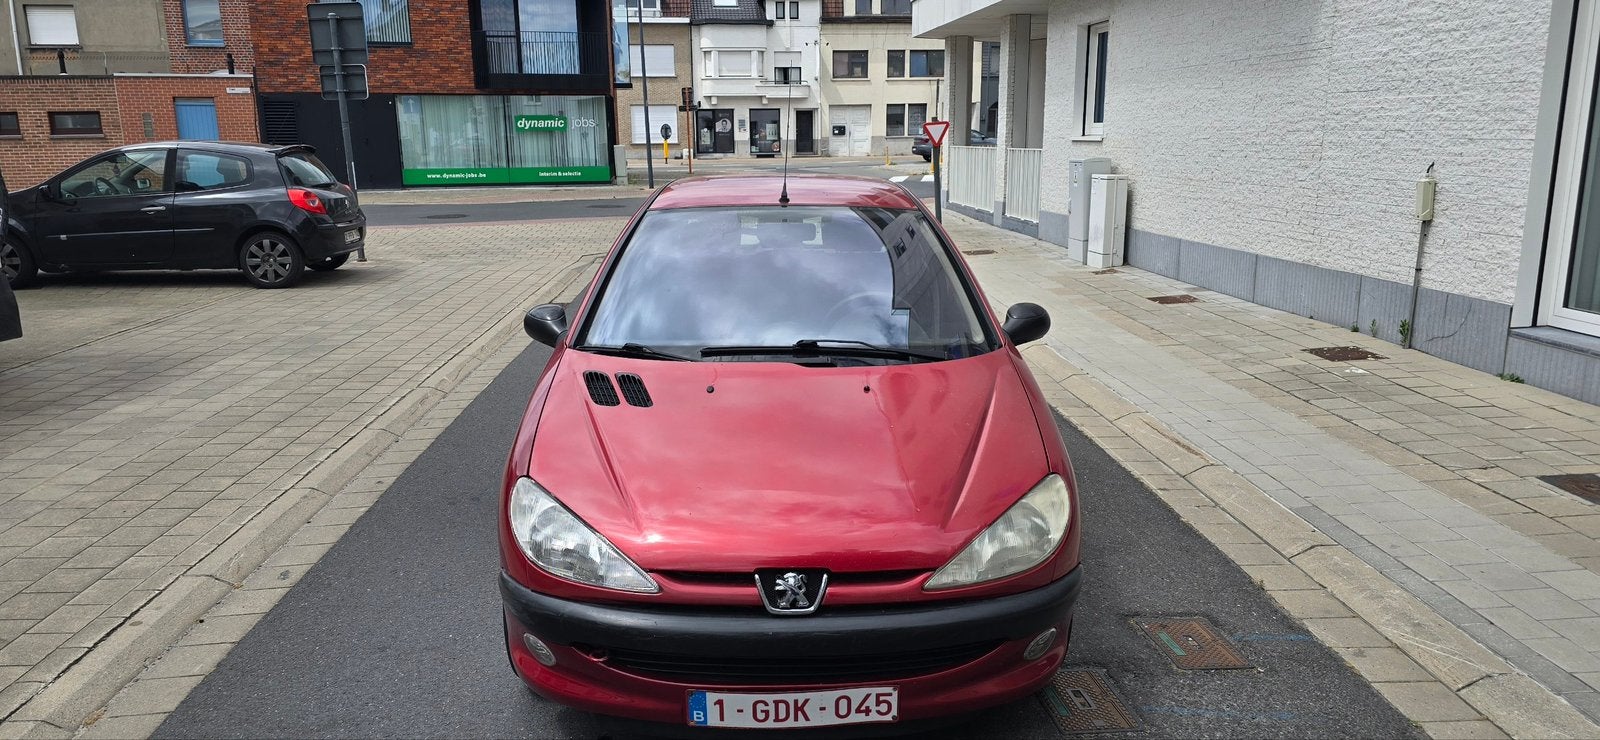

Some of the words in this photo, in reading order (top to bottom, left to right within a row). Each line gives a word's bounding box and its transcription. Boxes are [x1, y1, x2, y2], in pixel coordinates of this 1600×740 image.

[517, 117, 565, 130] dynamic
[571, 116, 596, 130] jobs
[693, 710, 705, 722] B
